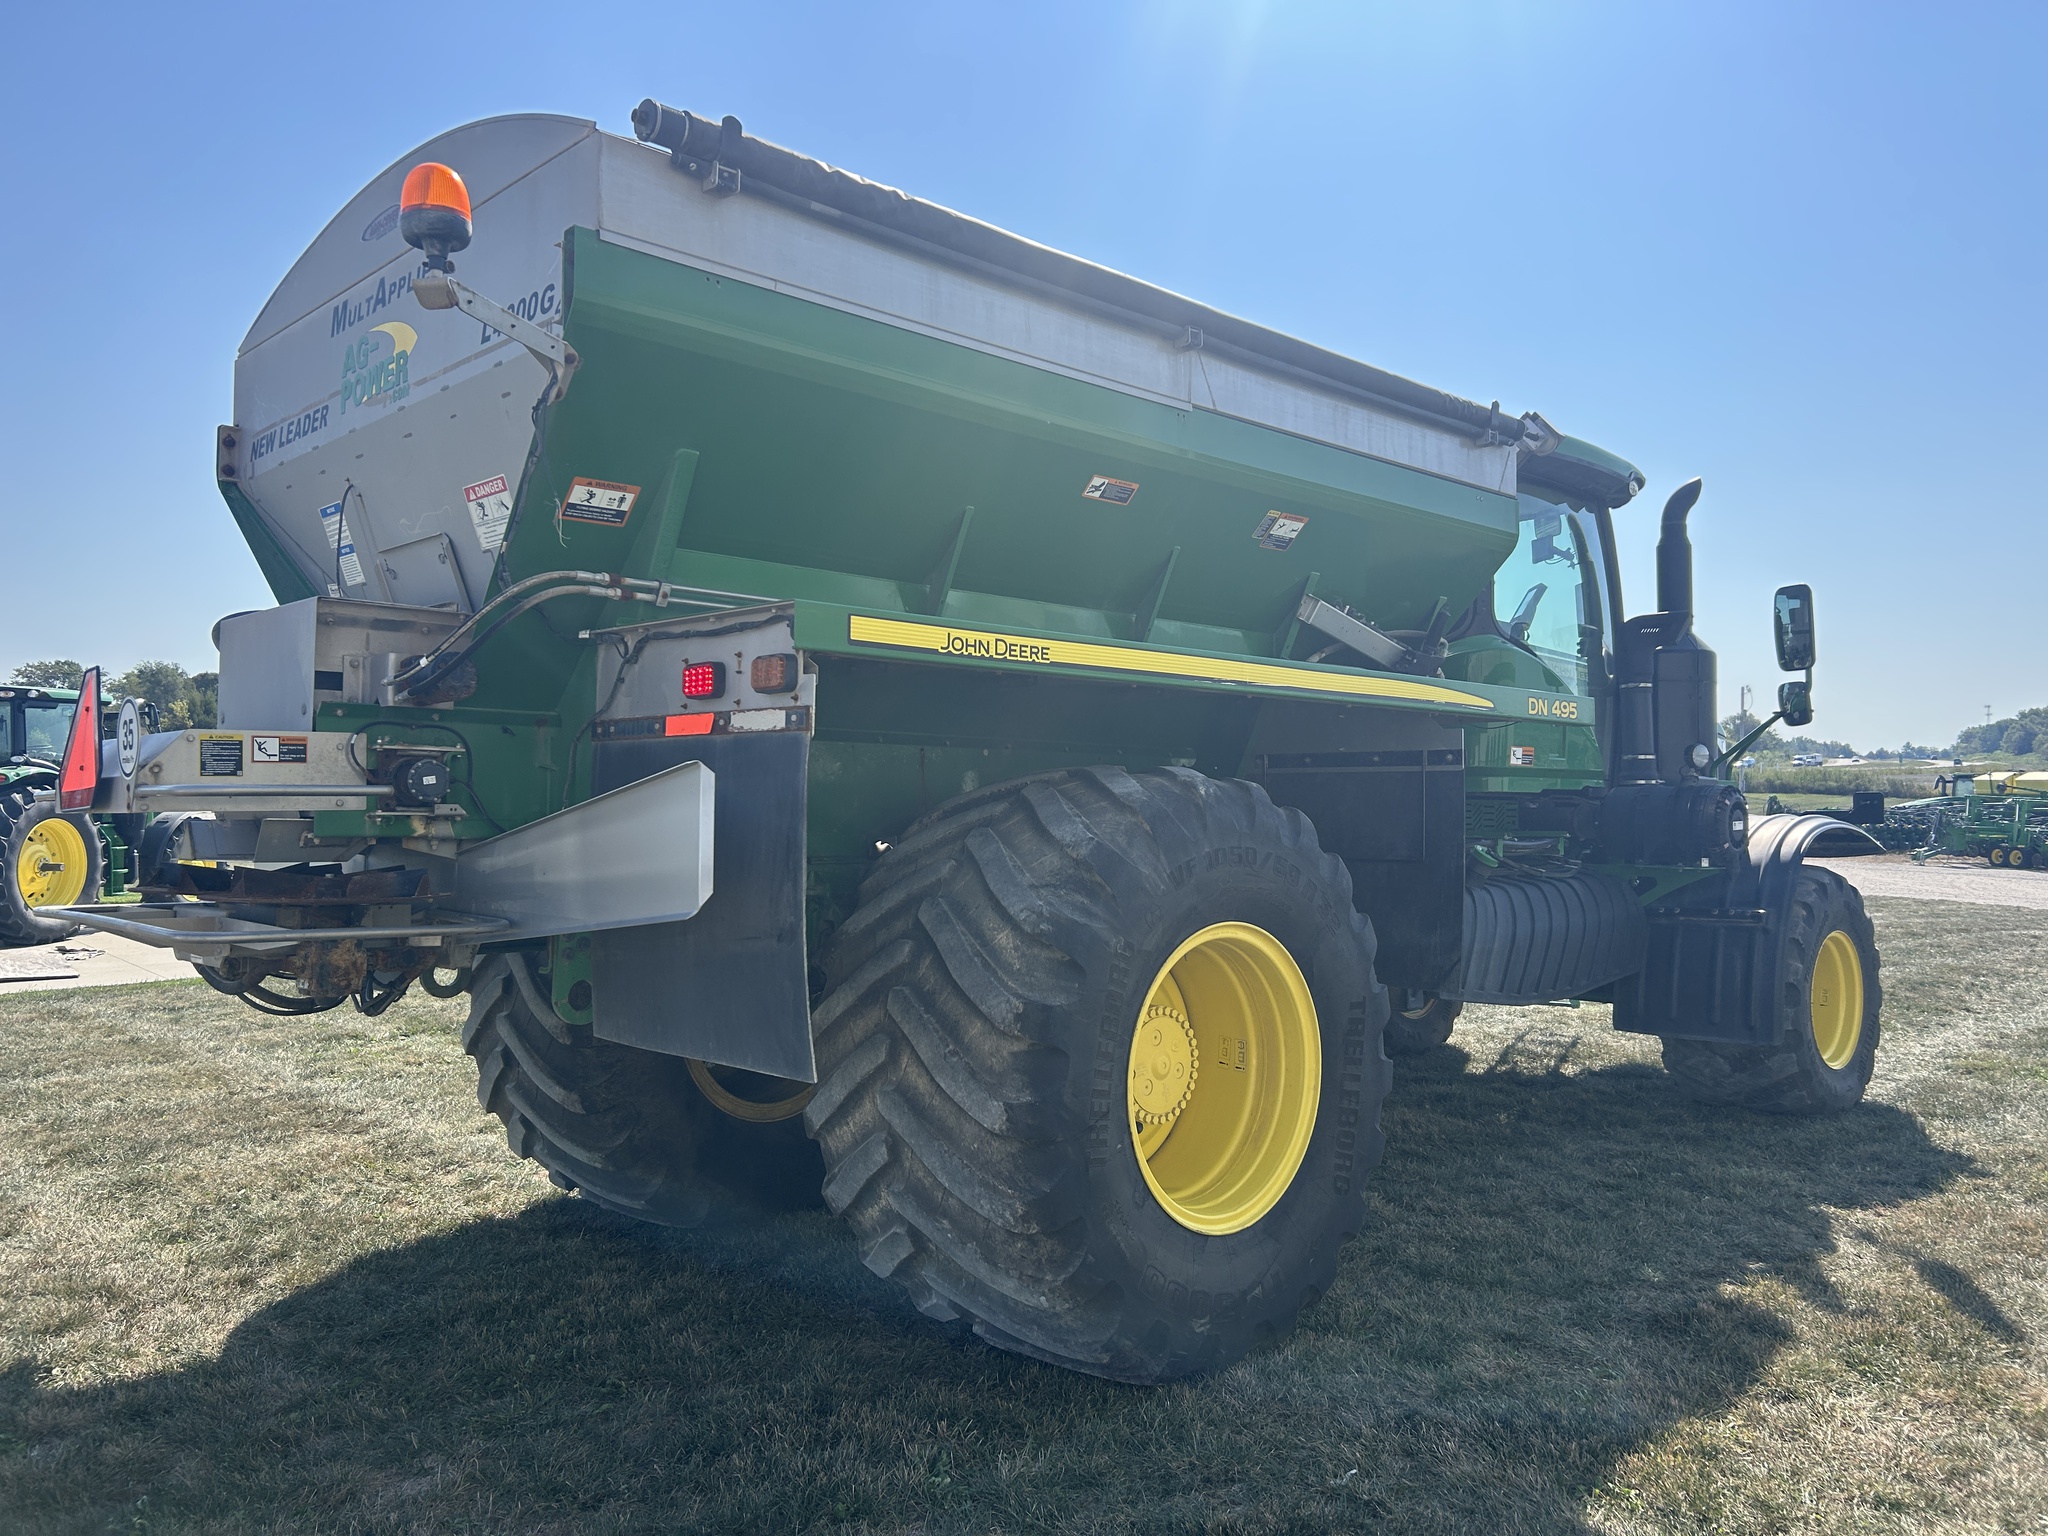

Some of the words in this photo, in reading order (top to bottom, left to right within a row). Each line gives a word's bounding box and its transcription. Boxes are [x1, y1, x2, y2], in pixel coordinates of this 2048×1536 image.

[342, 335, 379, 379] AG-
[341, 350, 408, 415] POWER
[250, 429, 277, 463] NEW
[279, 404, 329, 448] LEADER
[475, 480, 505, 498] DANGER
[596, 481, 628, 491] WARNING
[940, 632, 990, 655] JOHN
[995, 638, 1050, 661] DEERE
[1528, 697, 1548, 716] DN
[1551, 700, 1578, 719] 495
[122, 718, 134, 751] 35
[1085, 936, 1135, 1175] TRELLEBORG
[1333, 996, 1367, 1197] TRELLEBORG
